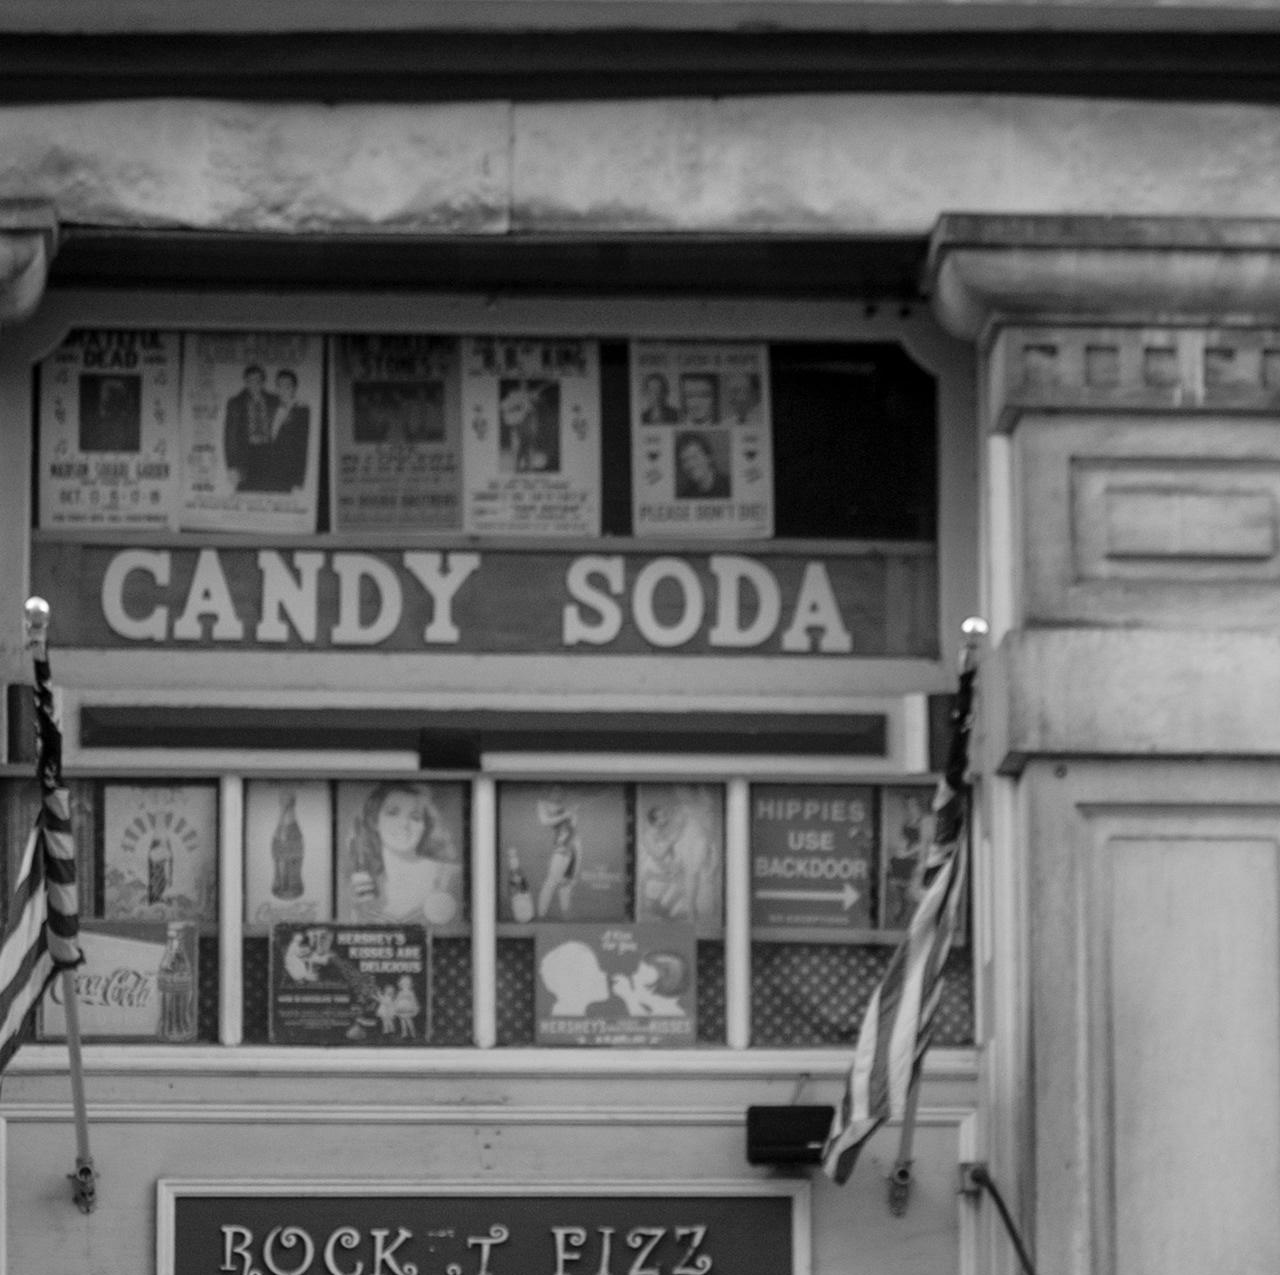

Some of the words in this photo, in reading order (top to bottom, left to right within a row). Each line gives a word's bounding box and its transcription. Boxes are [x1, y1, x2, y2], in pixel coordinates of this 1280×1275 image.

[83, 351, 139, 368] DEAD
[640, 504, 690, 521] PLEASE
[101, 549, 480, 643] CANDY
[563, 556, 853, 652] SODA
[757, 799, 866, 822] HIPPIES
[788, 831, 835, 850] USE
[756, 857, 868, 879] BACKDOOR
[337, 933, 406, 945] HERSHEY'S
[349, 947, 394, 959] KISSES
[396, 947, 422, 959] ARE
[360, 960, 423, 972] DELICIOUS
[540, 1020, 606, 1033] HERSHEY'S
[648, 1020, 693, 1033] KISSES
